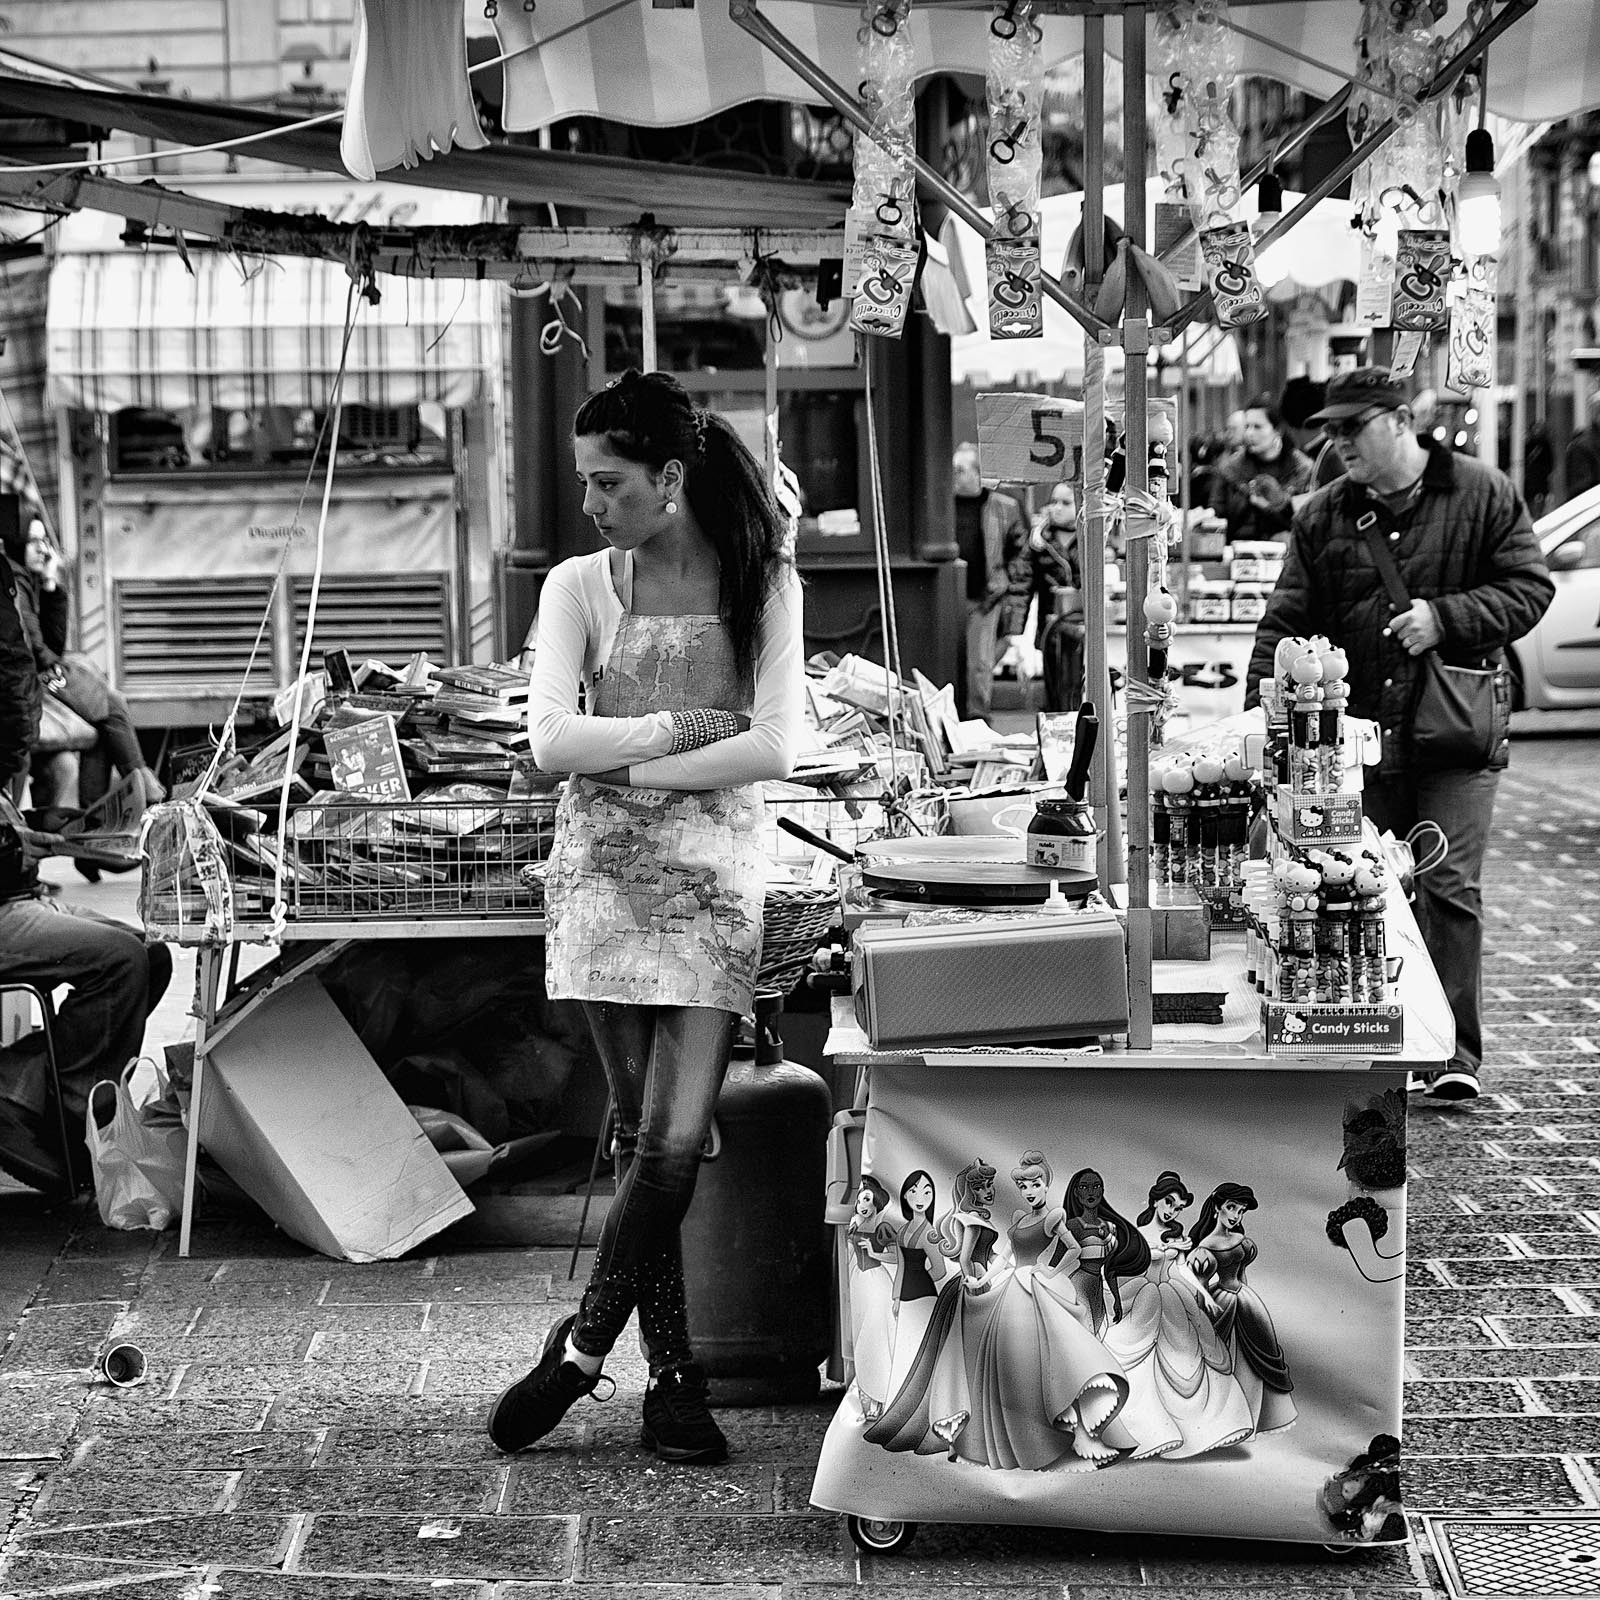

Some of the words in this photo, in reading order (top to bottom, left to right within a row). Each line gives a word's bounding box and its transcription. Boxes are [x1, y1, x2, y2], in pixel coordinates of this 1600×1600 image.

[1330, 809, 1356, 819] Candy
[629, 873, 661, 885] India
[587, 970, 659, 985] Oceania
[1311, 1007, 1345, 1016] HELLO
[1348, 1007, 1379, 1016] KITTY
[1311, 1022, 1351, 1037] Candy
[1353, 1022, 1390, 1034] Sticks
